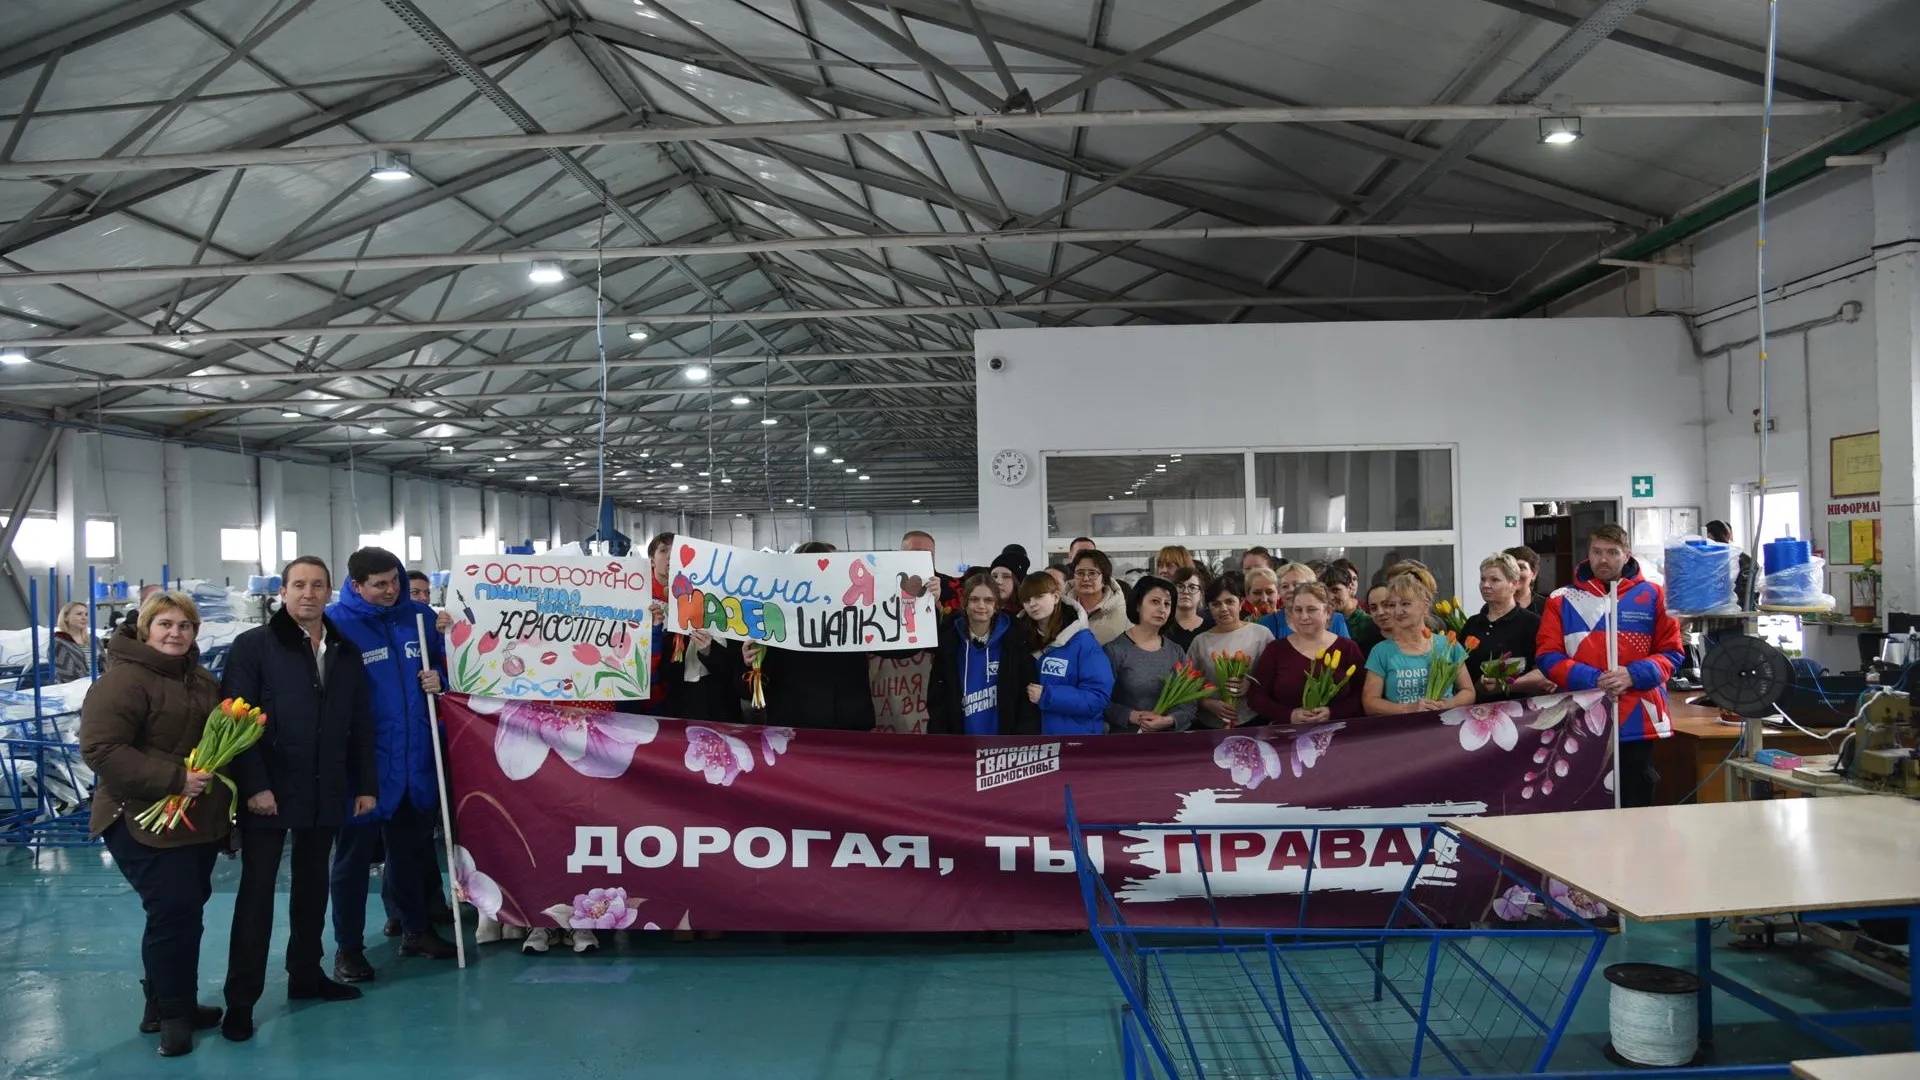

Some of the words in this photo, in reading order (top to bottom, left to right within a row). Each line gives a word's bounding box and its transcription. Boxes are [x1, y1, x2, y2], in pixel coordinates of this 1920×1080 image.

[484, 562, 645, 591] ОСТОРОЖНО
[689, 548, 831, 604] Мама,
[842, 558, 876, 606] Я
[676, 588, 787, 643] НАДЕЛ
[1397, 679, 1419, 688] ARE
[979, 758, 1056, 789] ПОДМОСКОВЬЕ
[567, 825, 954, 876] ДОРОГАЯ,
[985, 835, 1105, 874] ТЫ
